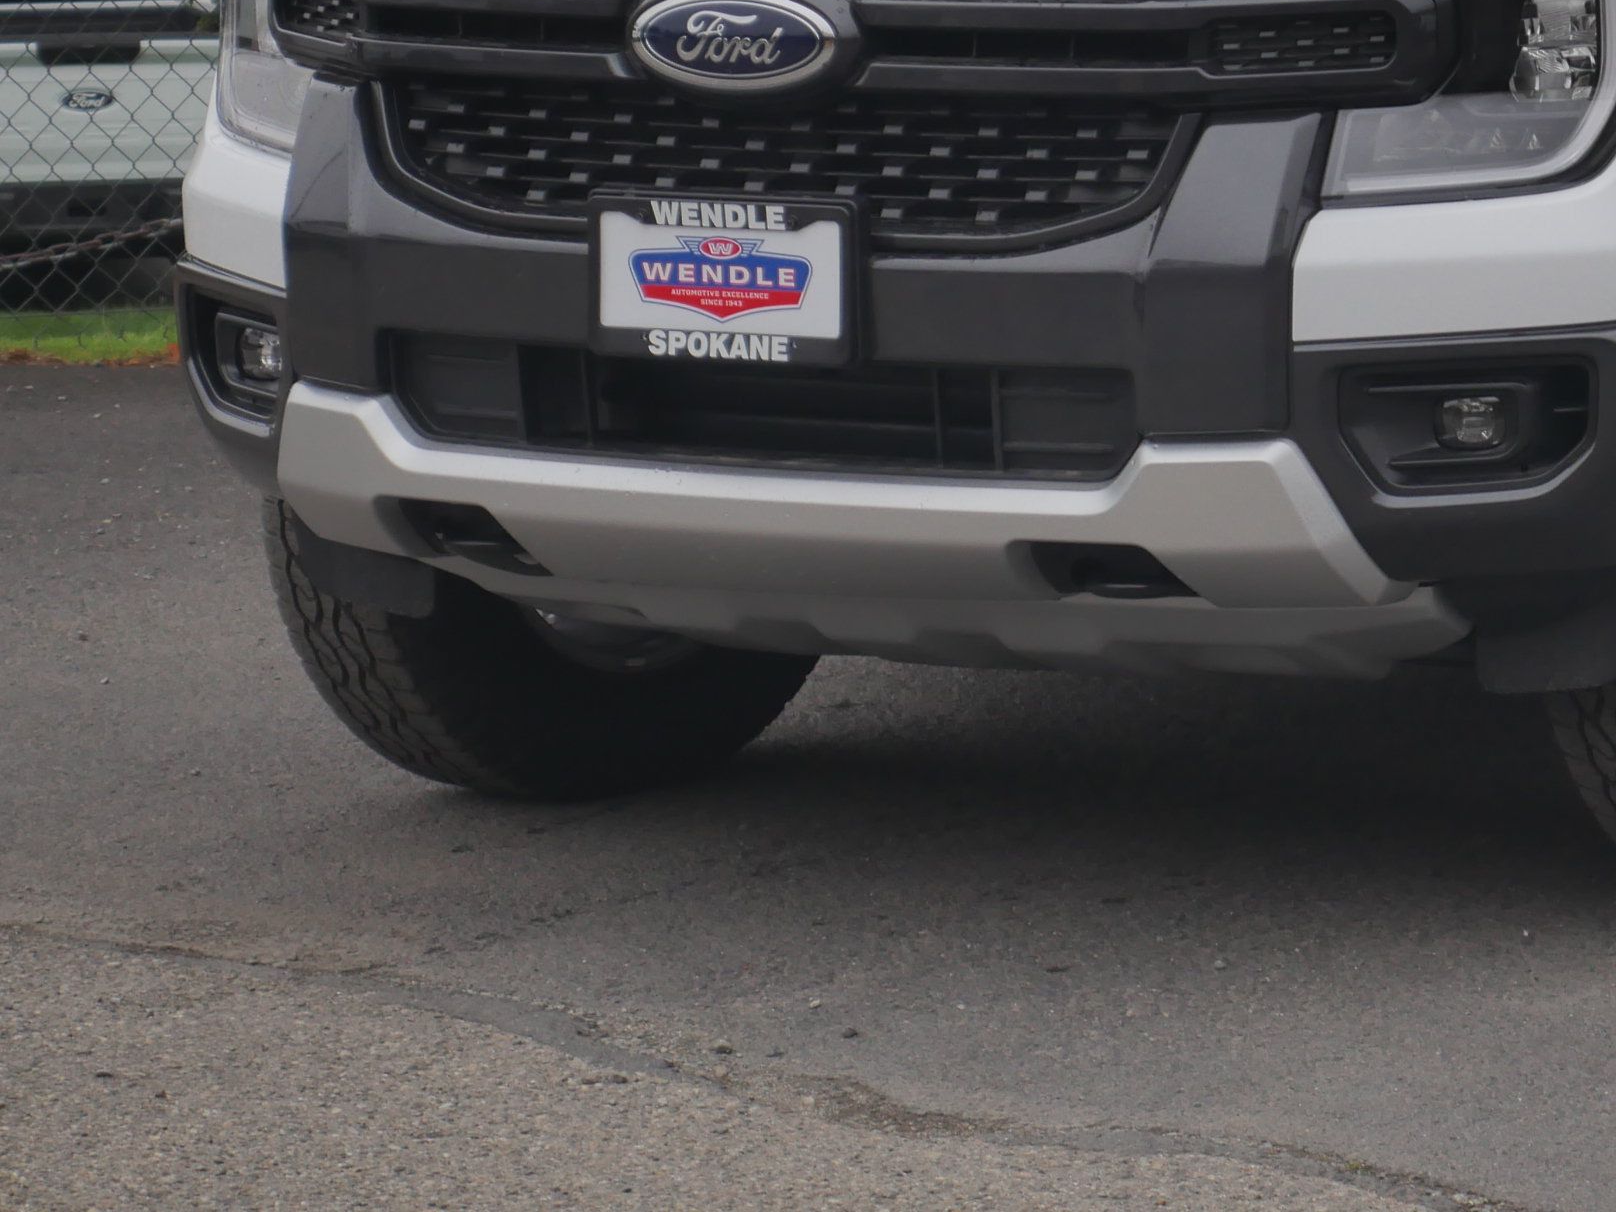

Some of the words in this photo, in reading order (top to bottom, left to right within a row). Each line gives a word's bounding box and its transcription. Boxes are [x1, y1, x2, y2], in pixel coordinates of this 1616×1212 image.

[676, 10, 784, 66] Ford
[68, 93, 106, 108] Ford
[650, 199, 787, 231] WENDLE
[641, 261, 795, 287] WENDLE
[671, 289, 721, 298] AUTOMOTIVE
[722, 290, 769, 300] EXCELLENCE
[700, 298, 723, 306] SINCE
[725, 299, 743, 307] 1943
[648, 329, 789, 361] SPOKANE
